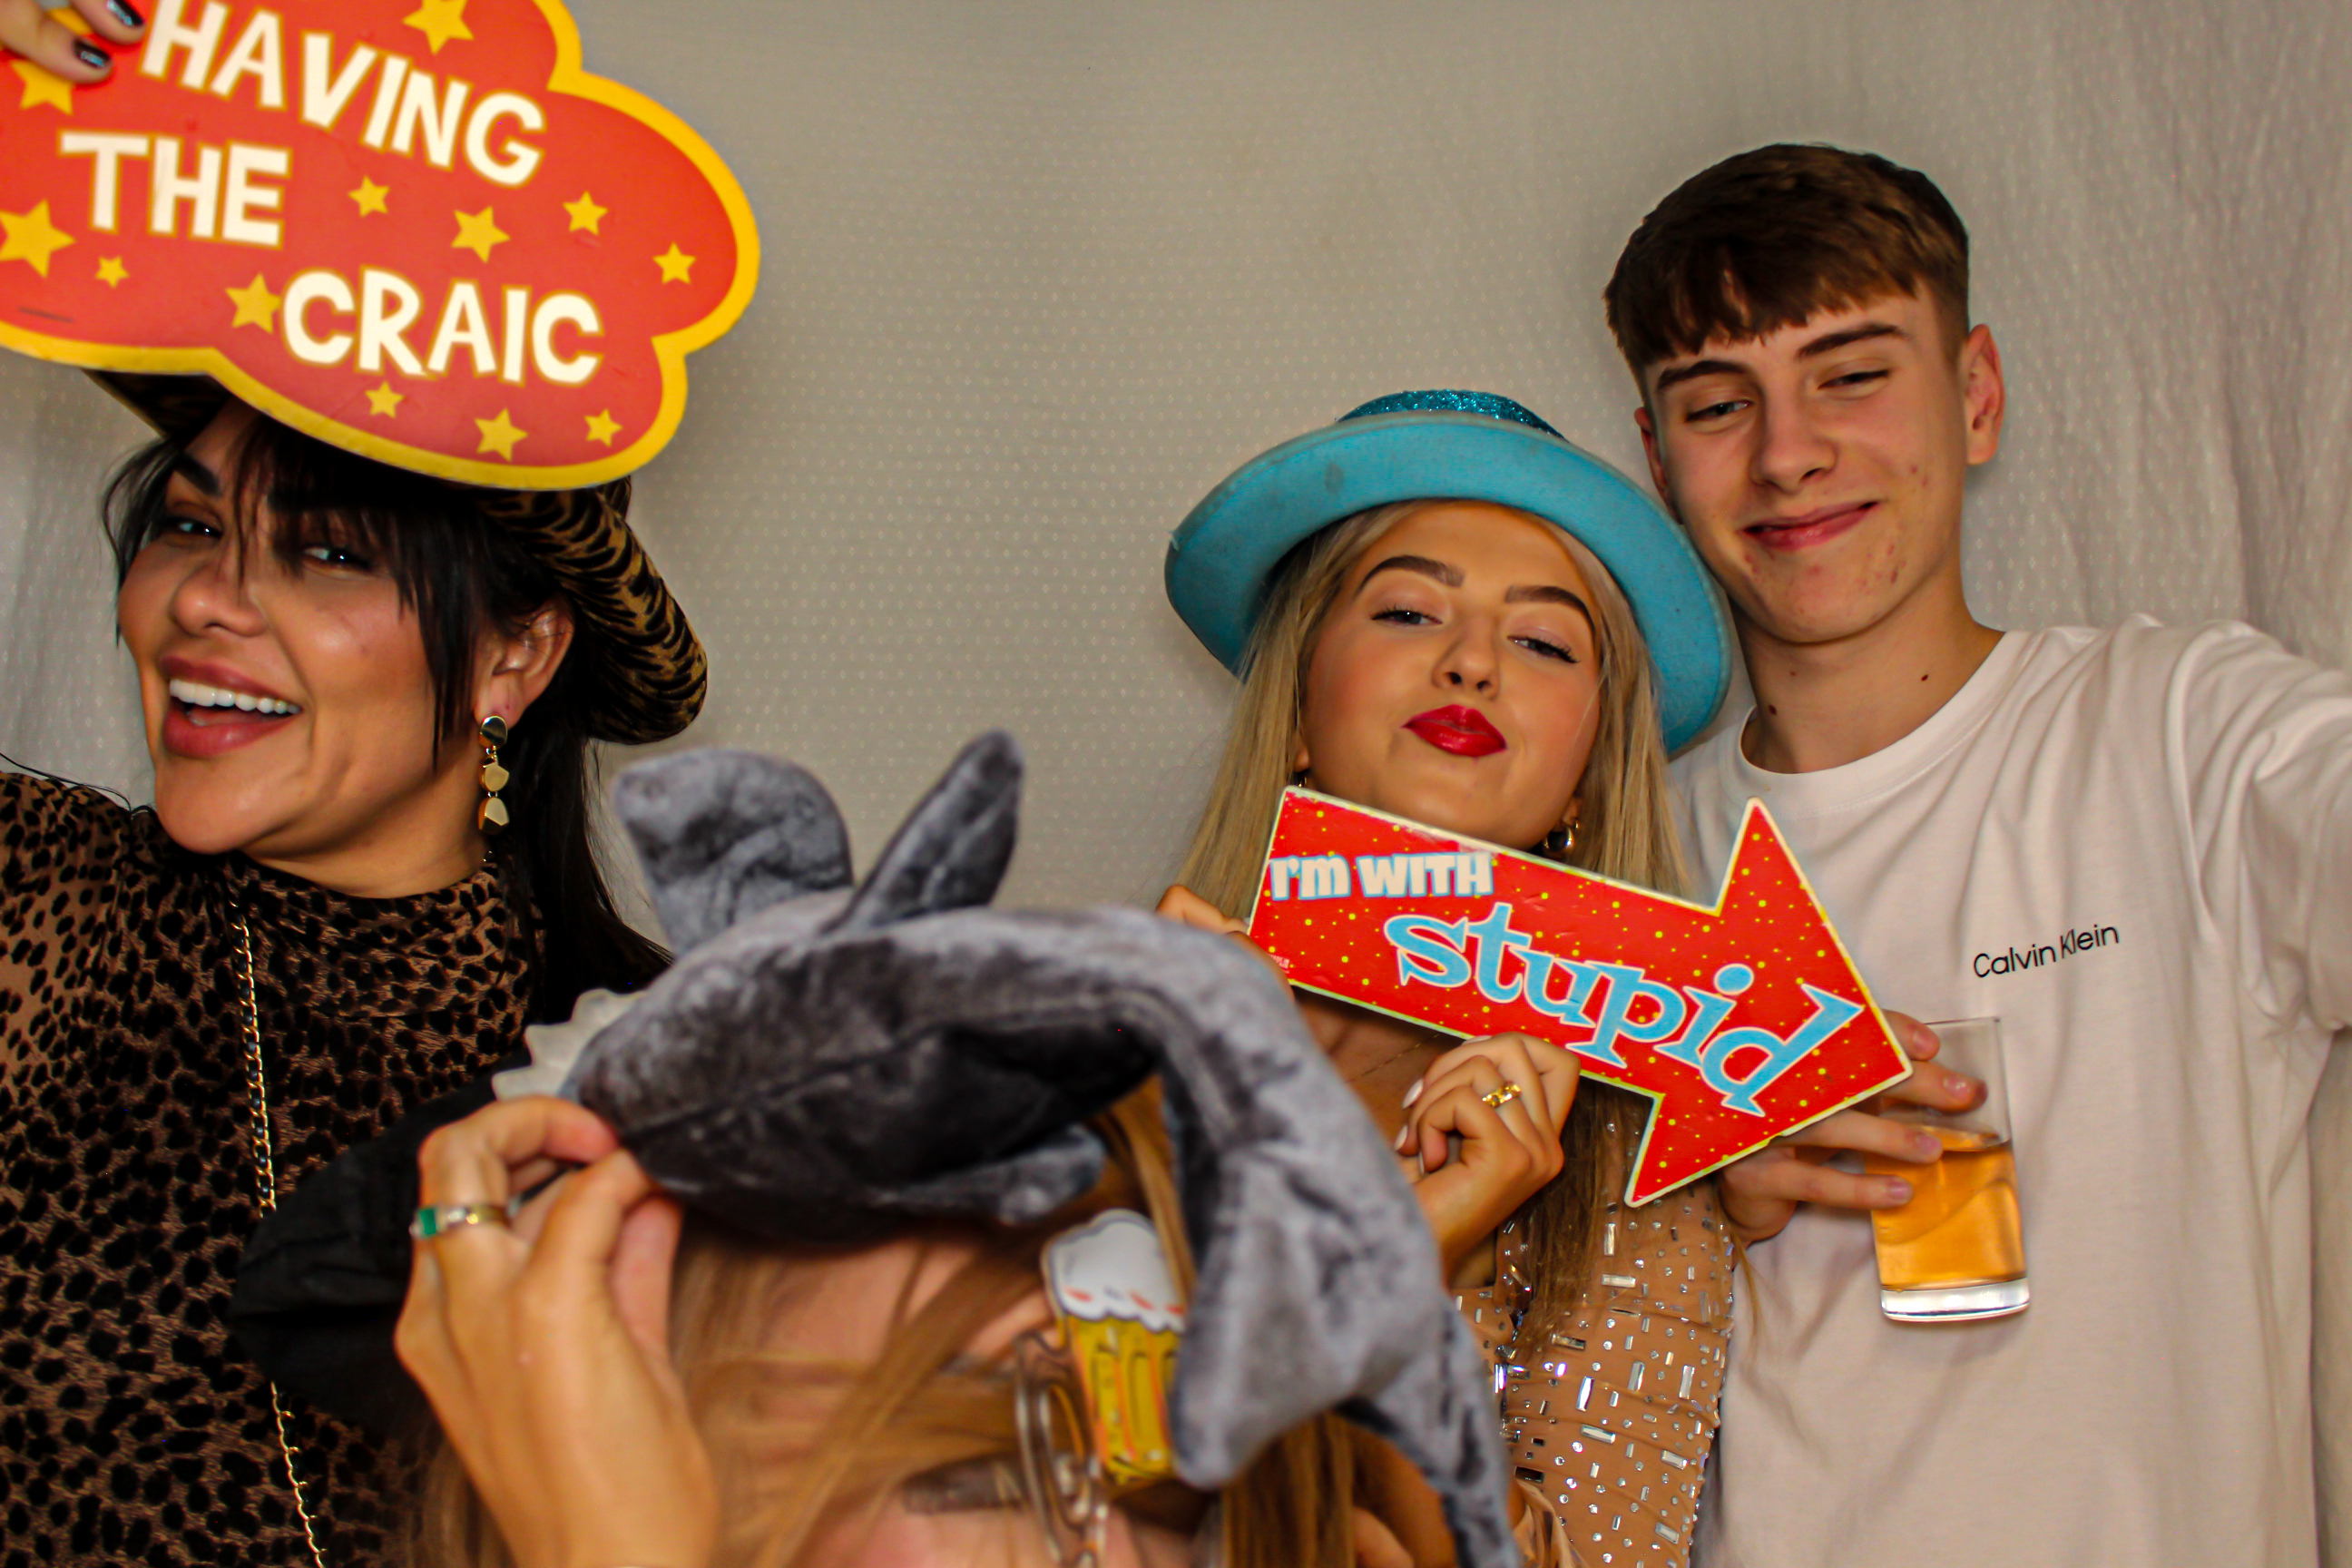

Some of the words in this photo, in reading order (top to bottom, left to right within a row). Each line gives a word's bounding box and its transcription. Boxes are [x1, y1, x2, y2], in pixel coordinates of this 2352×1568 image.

[140, 0, 544, 185] HAVING
[59, 130, 289, 247] THE
[281, 264, 604, 385] CRAIC
[1356, 852, 1494, 897] WITH
[1384, 902, 1865, 1117] stupid
[1973, 943, 2056, 978] Calvin
[2060, 923, 2120, 959] Klein
